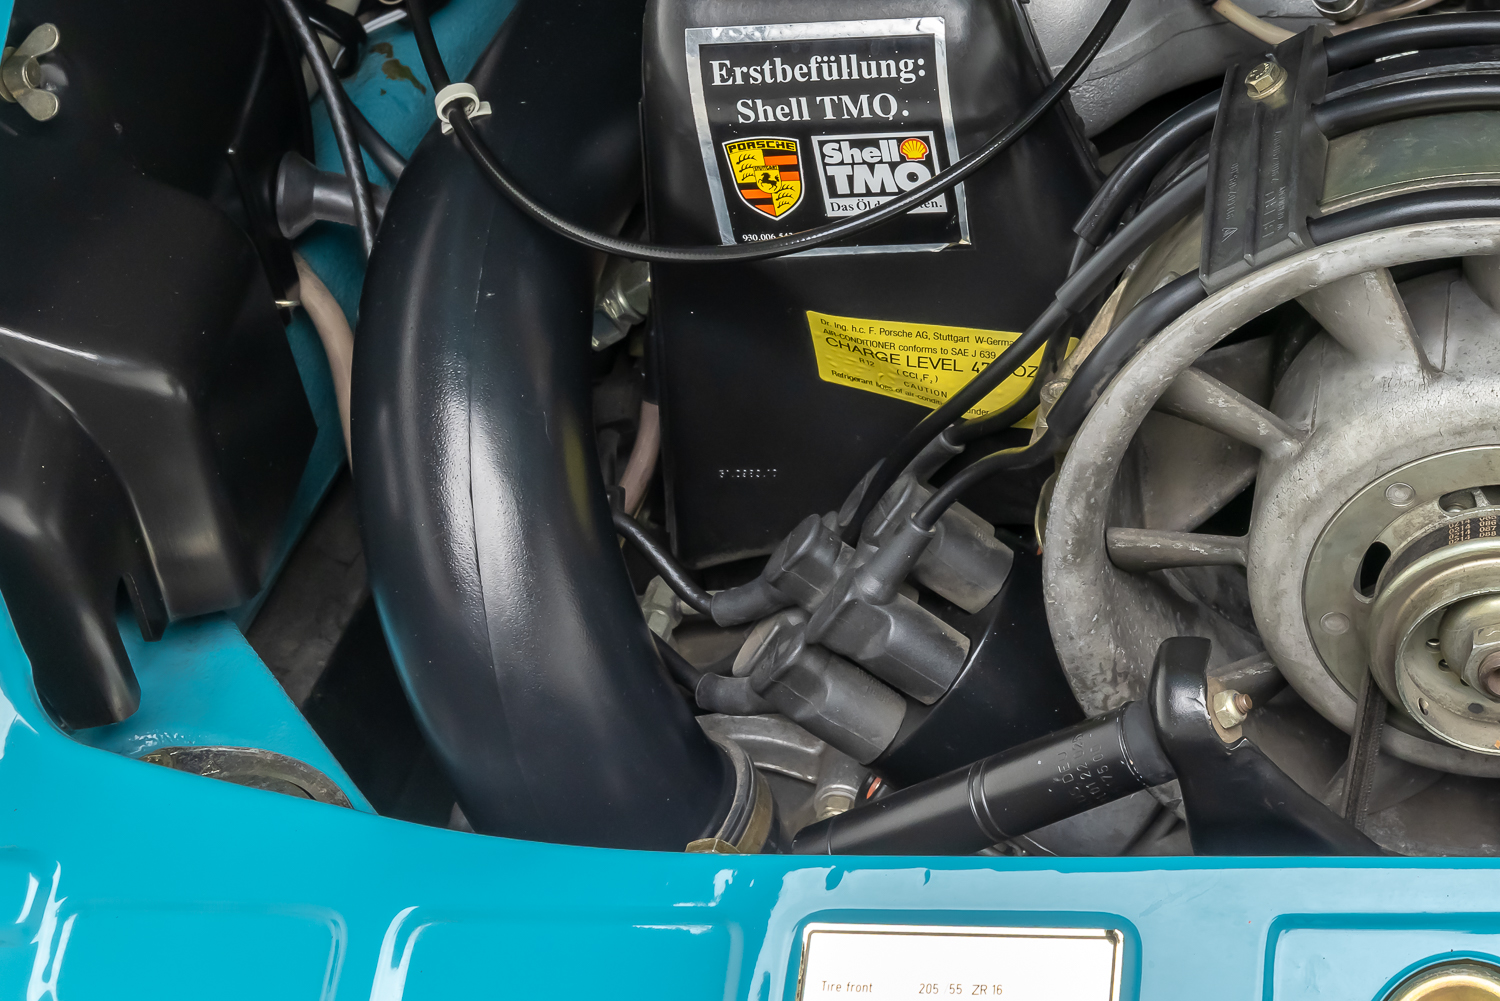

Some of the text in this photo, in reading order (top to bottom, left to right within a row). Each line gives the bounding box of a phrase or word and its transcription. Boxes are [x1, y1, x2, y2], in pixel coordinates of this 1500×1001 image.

[709, 53, 926, 87] Erstbefüllung:
[735, 96, 811, 124] Shell
[728, 140, 797, 154] PORSCHE
[822, 139, 900, 164] Shell
[825, 162, 931, 195] TMO
[830, 202, 855, 212] Das
[855, 199, 873, 212] Öl
[820, 318, 832, 328] Dr.
[833, 321, 849, 333] Ing.
[851, 324, 866, 334] h.c.
[868, 326, 877, 335] F.
[879, 327, 913, 339] Porsche
[914, 329, 931, 341] AG,
[933, 331, 970, 344] Stuttgart
[823, 328, 997, 359] AIR-CONDITIONER conforms to SAE J 639
[825, 336, 901, 366] CHARGE
[906, 355, 964, 373] LEVEL
[831, 370, 874, 387] Refrigerant
[903, 381, 948, 399] CAUTION
[821, 980, 1003, 996] Tire front 205 ZR 16
